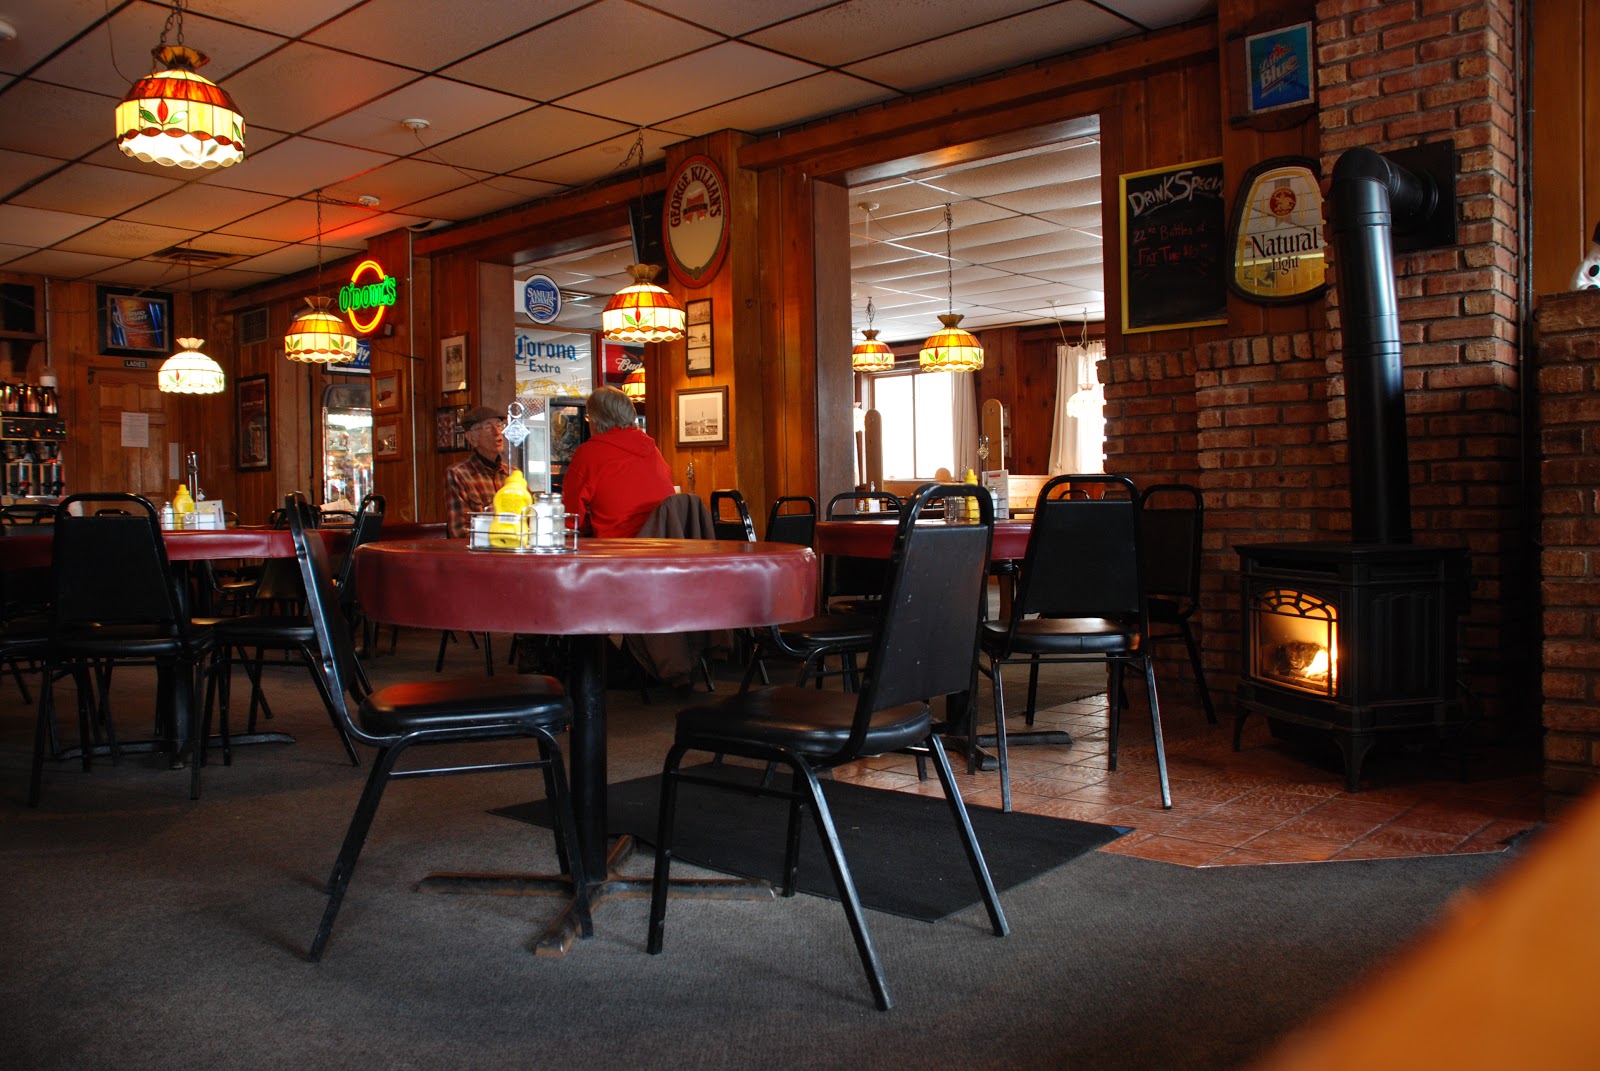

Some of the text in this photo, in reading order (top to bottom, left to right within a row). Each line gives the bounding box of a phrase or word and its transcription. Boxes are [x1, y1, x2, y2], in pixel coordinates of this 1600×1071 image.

[1261, 55, 1298, 89] Blue
[670, 166, 722, 228] GEORGE KILLIAN'S
[1128, 176, 1175, 217] DRINK
[1251, 227, 1319, 258] Natural
[1272, 256, 1299, 275] Light
[339, 275, 396, 313] O'DOUL'S
[527, 287, 557, 300] SAMUEL
[529, 297, 554, 308] ADAMS
[515, 335, 577, 363] Corona
[126, 360, 146, 368] LADIES
[528, 359, 561, 374] Extra
